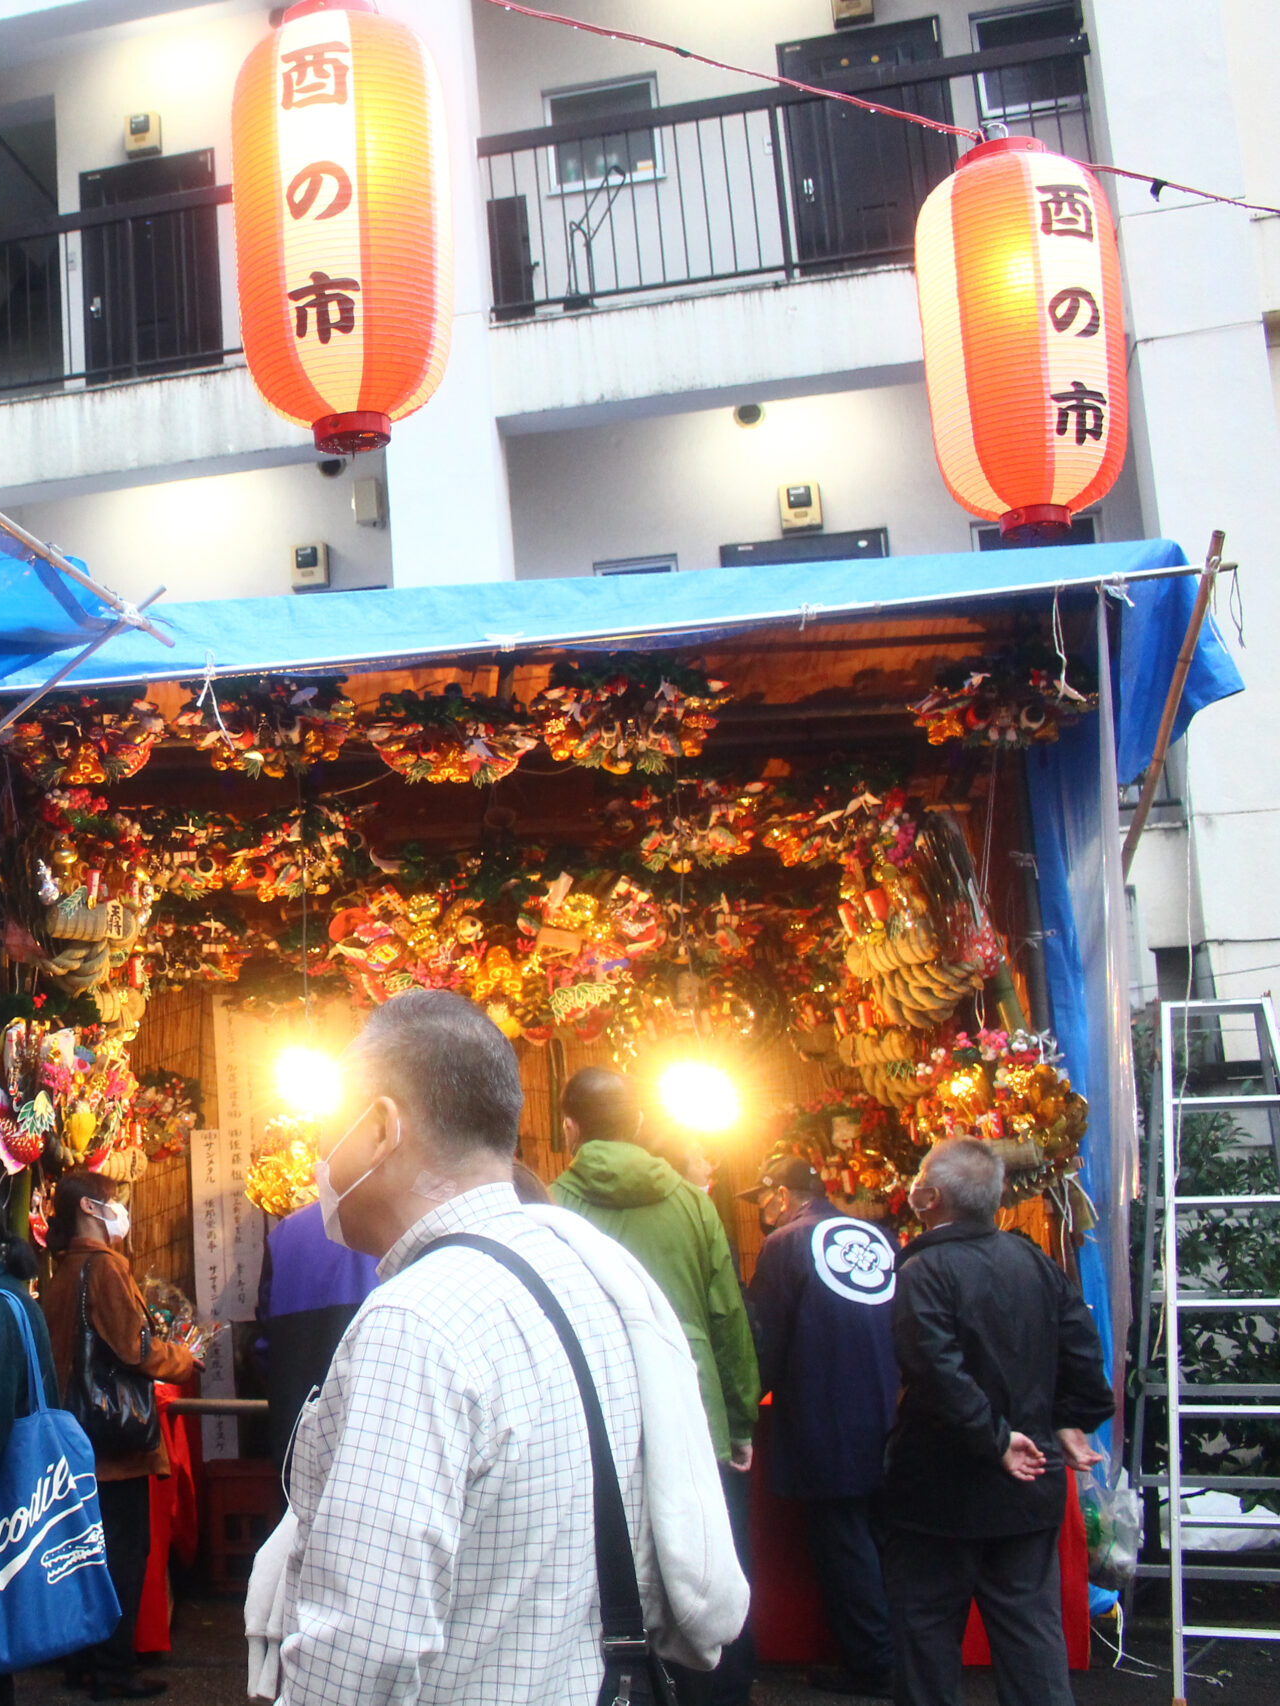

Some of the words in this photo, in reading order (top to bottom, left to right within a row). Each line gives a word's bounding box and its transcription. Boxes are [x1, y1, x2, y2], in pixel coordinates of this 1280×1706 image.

[280, 40, 361, 345] 酉の市
[1035, 184, 1107, 446] 酉の市
